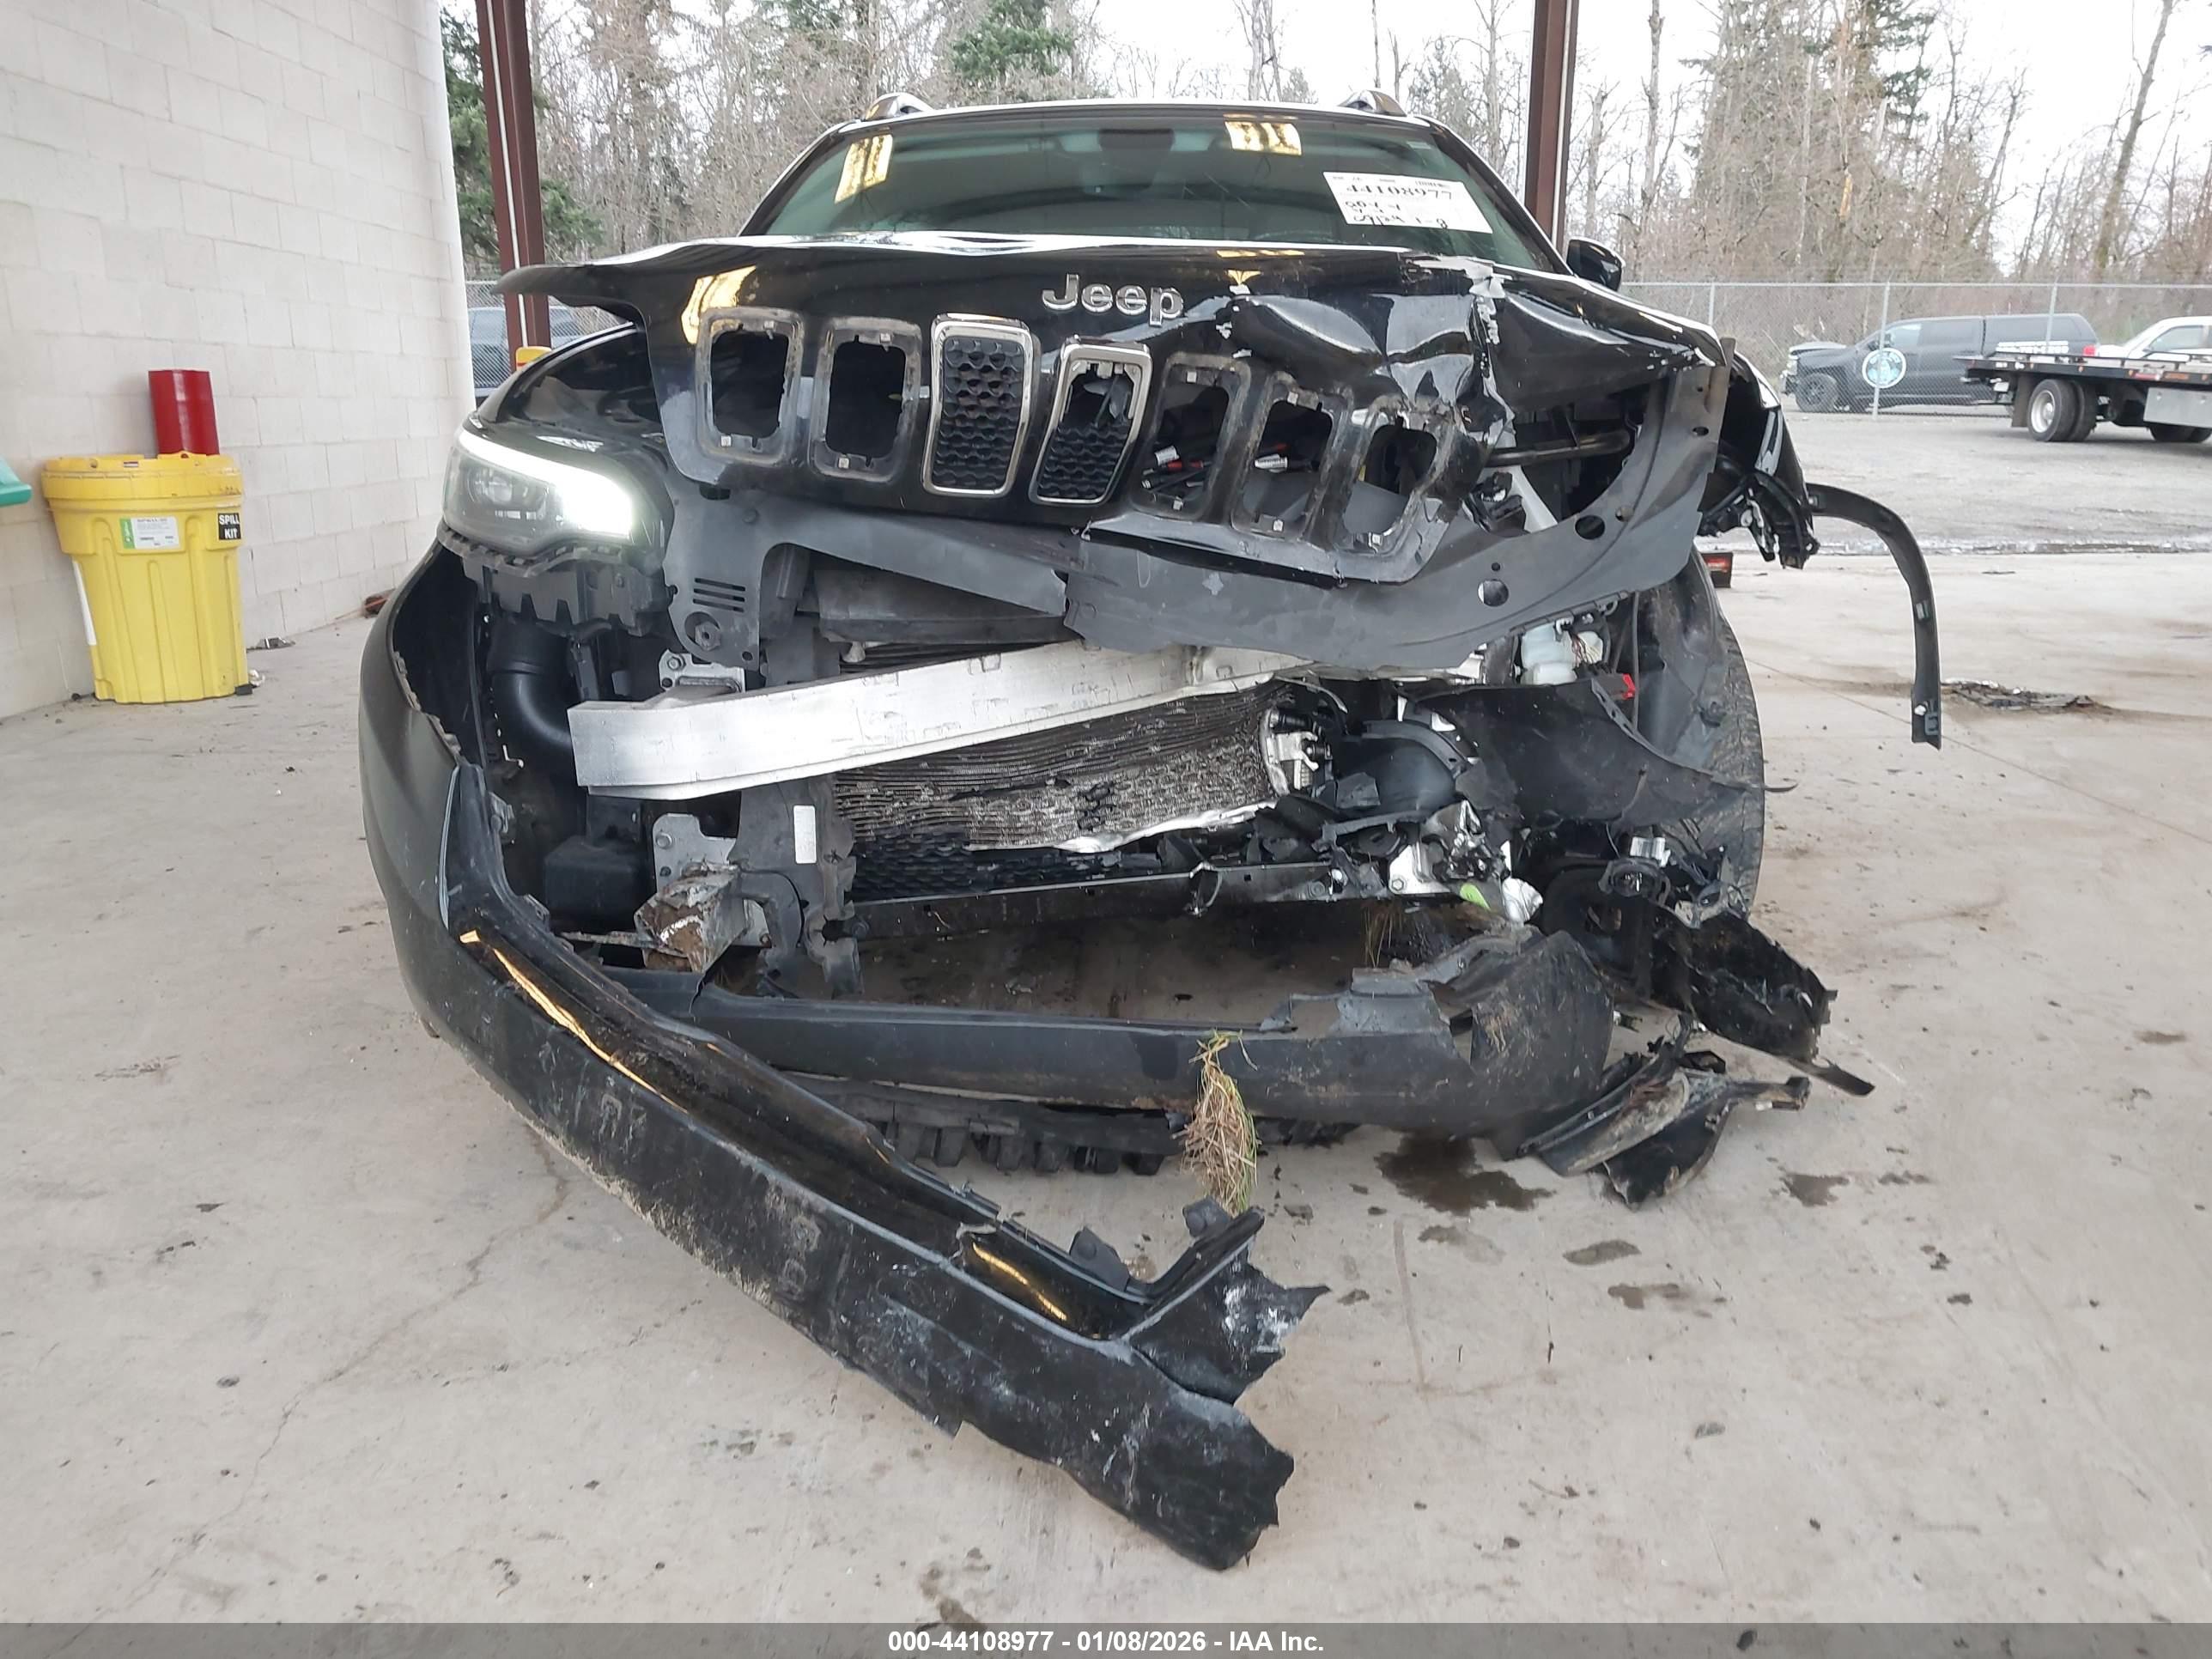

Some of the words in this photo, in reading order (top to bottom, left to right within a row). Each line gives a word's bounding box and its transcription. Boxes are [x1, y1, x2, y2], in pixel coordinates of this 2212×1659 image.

[1042, 274, 1184, 326] Jeep
[219, 514, 240, 526] SPILL
[224, 528, 238, 539] KIT
